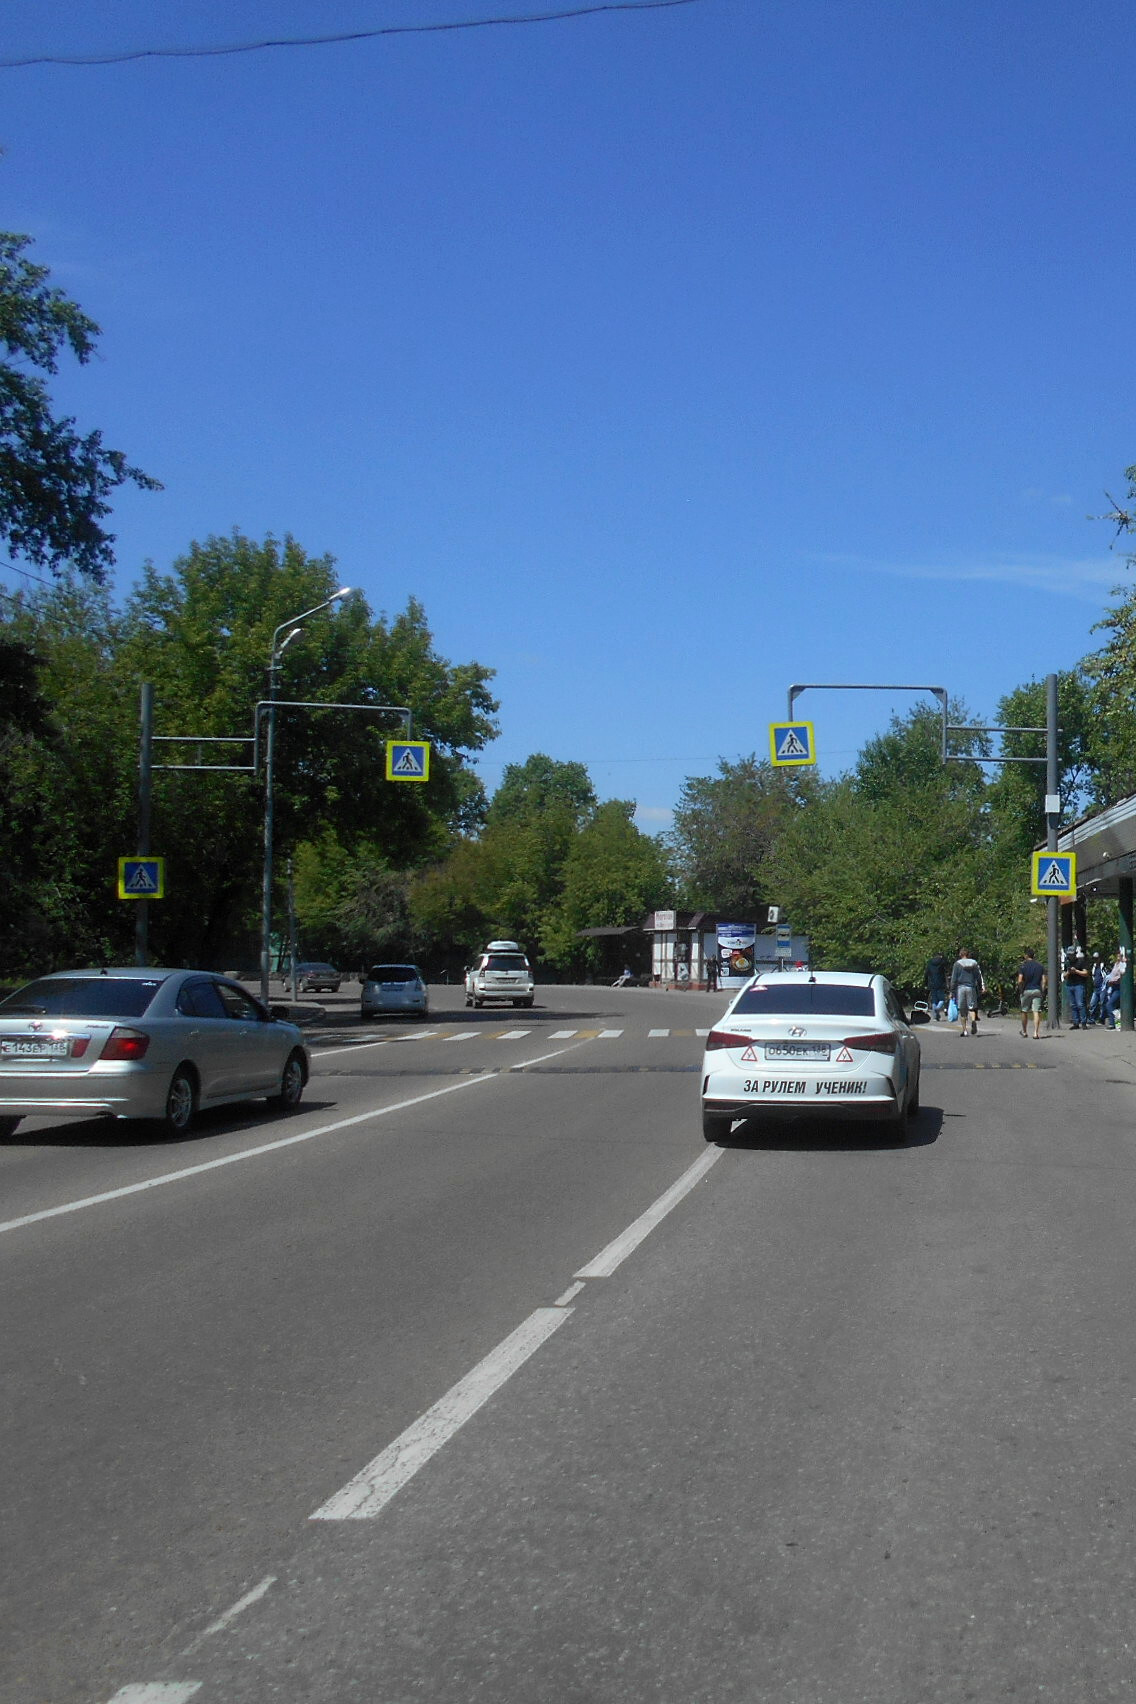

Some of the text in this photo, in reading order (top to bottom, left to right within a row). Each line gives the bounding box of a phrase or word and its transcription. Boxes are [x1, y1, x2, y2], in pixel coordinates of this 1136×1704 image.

[743, 1080, 868, 1095] ЗА РУЛЕМ УЧЕНИК!
